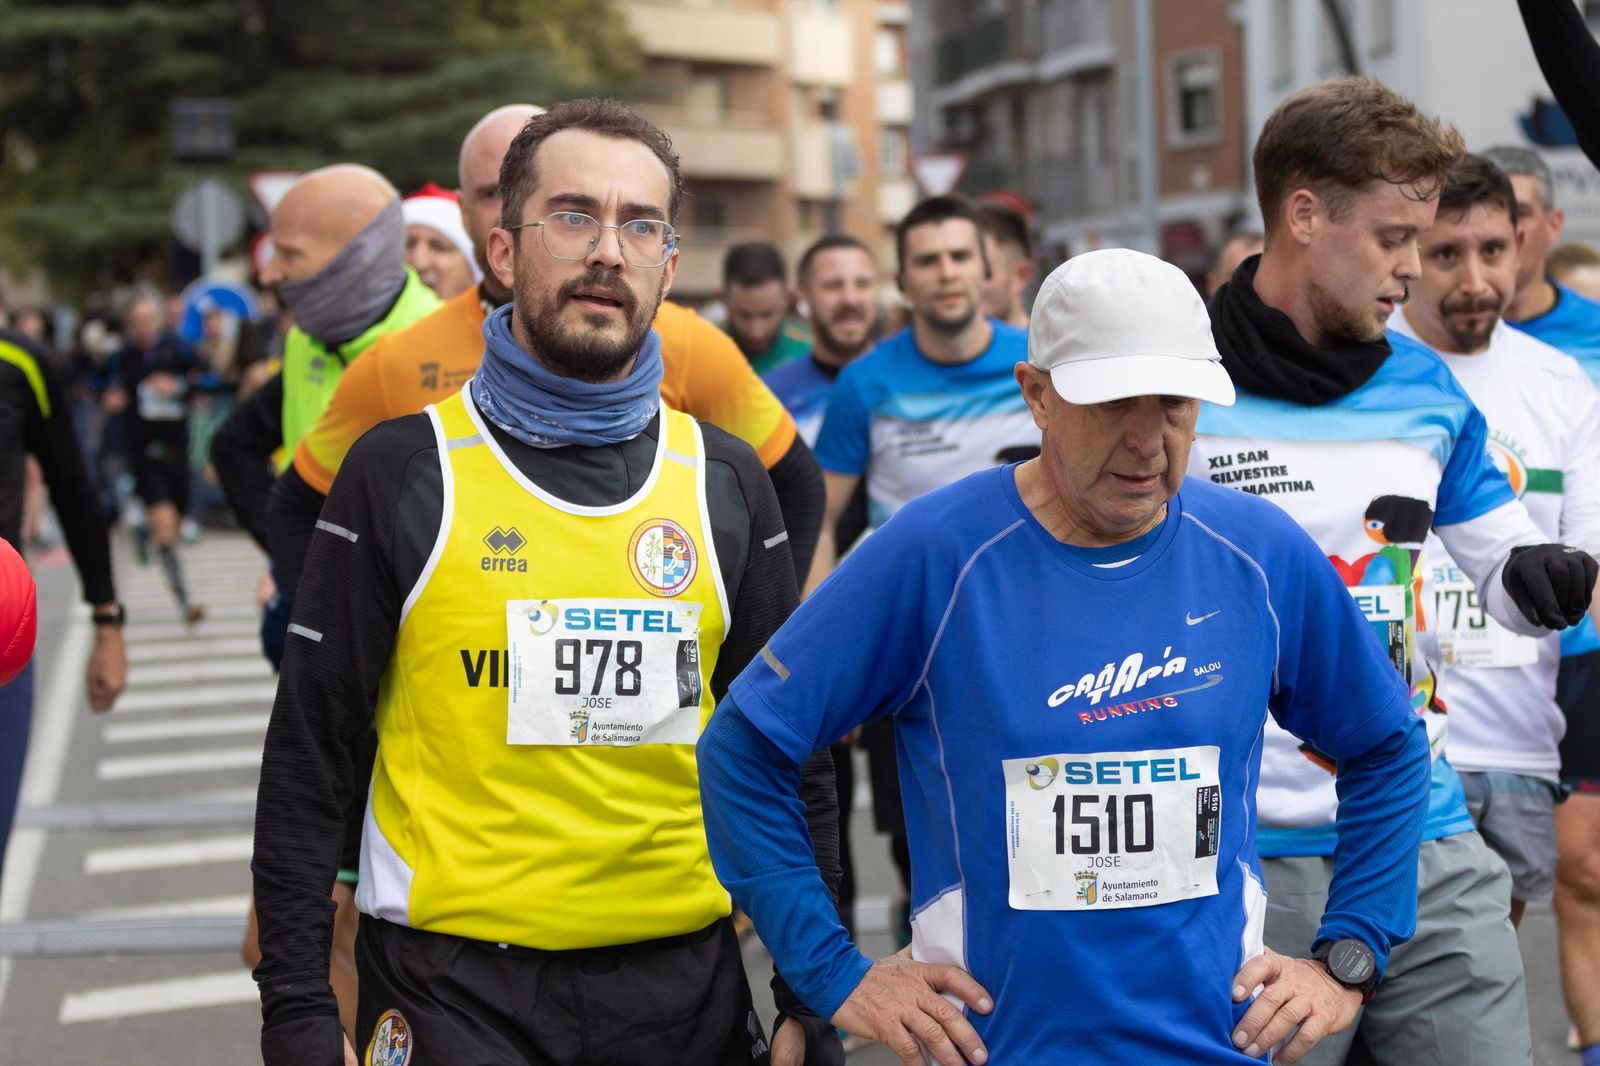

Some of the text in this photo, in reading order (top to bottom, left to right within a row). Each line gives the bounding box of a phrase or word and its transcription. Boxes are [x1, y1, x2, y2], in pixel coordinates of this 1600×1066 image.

[1208, 450, 1269, 470] XLI SAN
[1210, 465, 1288, 484] SILVESTRE
[1234, 480, 1314, 496] MANTINA
[481, 557, 528, 573] errea
[564, 607, 682, 633] SETEL
[555, 638, 642, 696] 978
[1193, 661, 1222, 677] SALOU
[582, 697, 612, 709] JOSE
[1078, 696, 1178, 725] RUNNING
[592, 722, 643, 732] Ayuntamiento
[591, 733, 641, 742] de Salamanca
[1065, 757, 1201, 785] SETEL
[1211, 792, 1219, 812] 1510
[1052, 793, 1154, 855] 1510
[1087, 856, 1121, 868] JOSE
[1102, 879, 1158, 892] Ayuntamiento
[1102, 891, 1158, 902] de Salamanca
